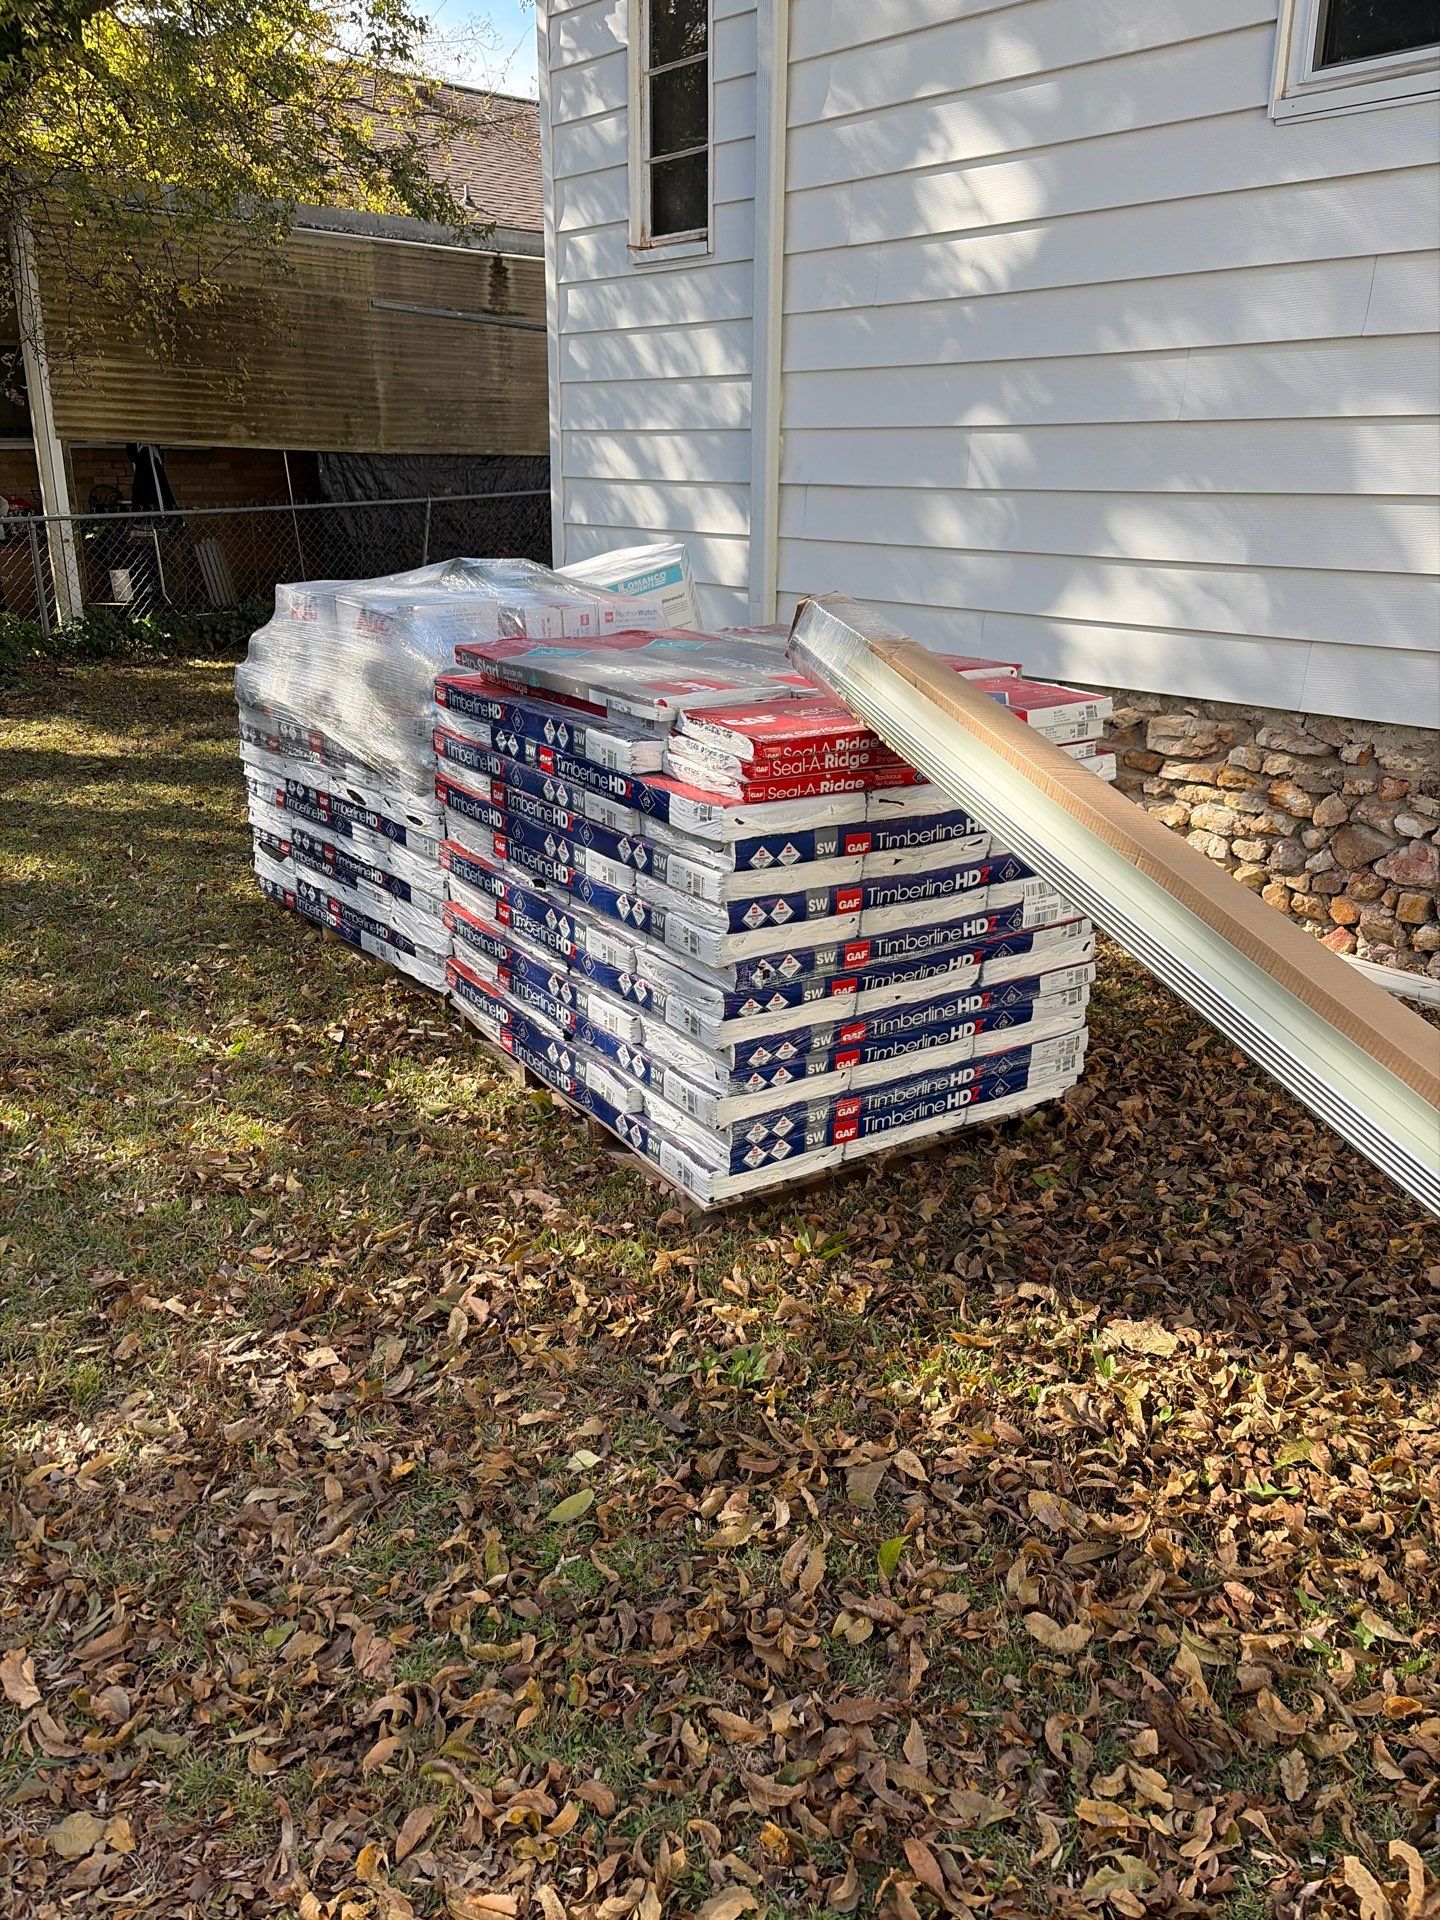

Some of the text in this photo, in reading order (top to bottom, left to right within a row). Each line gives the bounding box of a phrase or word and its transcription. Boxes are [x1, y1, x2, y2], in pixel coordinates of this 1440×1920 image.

[573, 729, 586, 746] SW
[525, 743, 536, 758] SW
[755, 766, 770, 774] GAF
[772, 752, 870, 777] Seal-A-Ridge
[572, 787, 585, 807] SW
[816, 841, 837, 855] SW
[847, 842, 870, 853] GAF
[574, 850, 586, 866] SW
[653, 852, 668, 871] SW
[808, 898, 828, 912] SW
[838, 898, 861, 910] GAF
[651, 910, 666, 929] SW
[574, 924, 586, 942] SW
[816, 951, 836, 965] SW
[846, 950, 868, 962] GAF
[576, 992, 588, 1009] SW
[652, 990, 667, 1008] SW
[803, 988, 824, 1001] SW
[813, 1034, 832, 1047] SW
[575, 1063, 587, 1077] SW
[807, 1060, 827, 1073] SW
[836, 1058, 858, 1070] GAF
[650, 1066, 664, 1084] SW
[808, 1110, 827, 1122] SW
[837, 1105, 859, 1118] GAF
[805, 1131, 826, 1145] SW
[835, 1127, 857, 1140] GAF
[648, 1138, 660, 1154] SW
